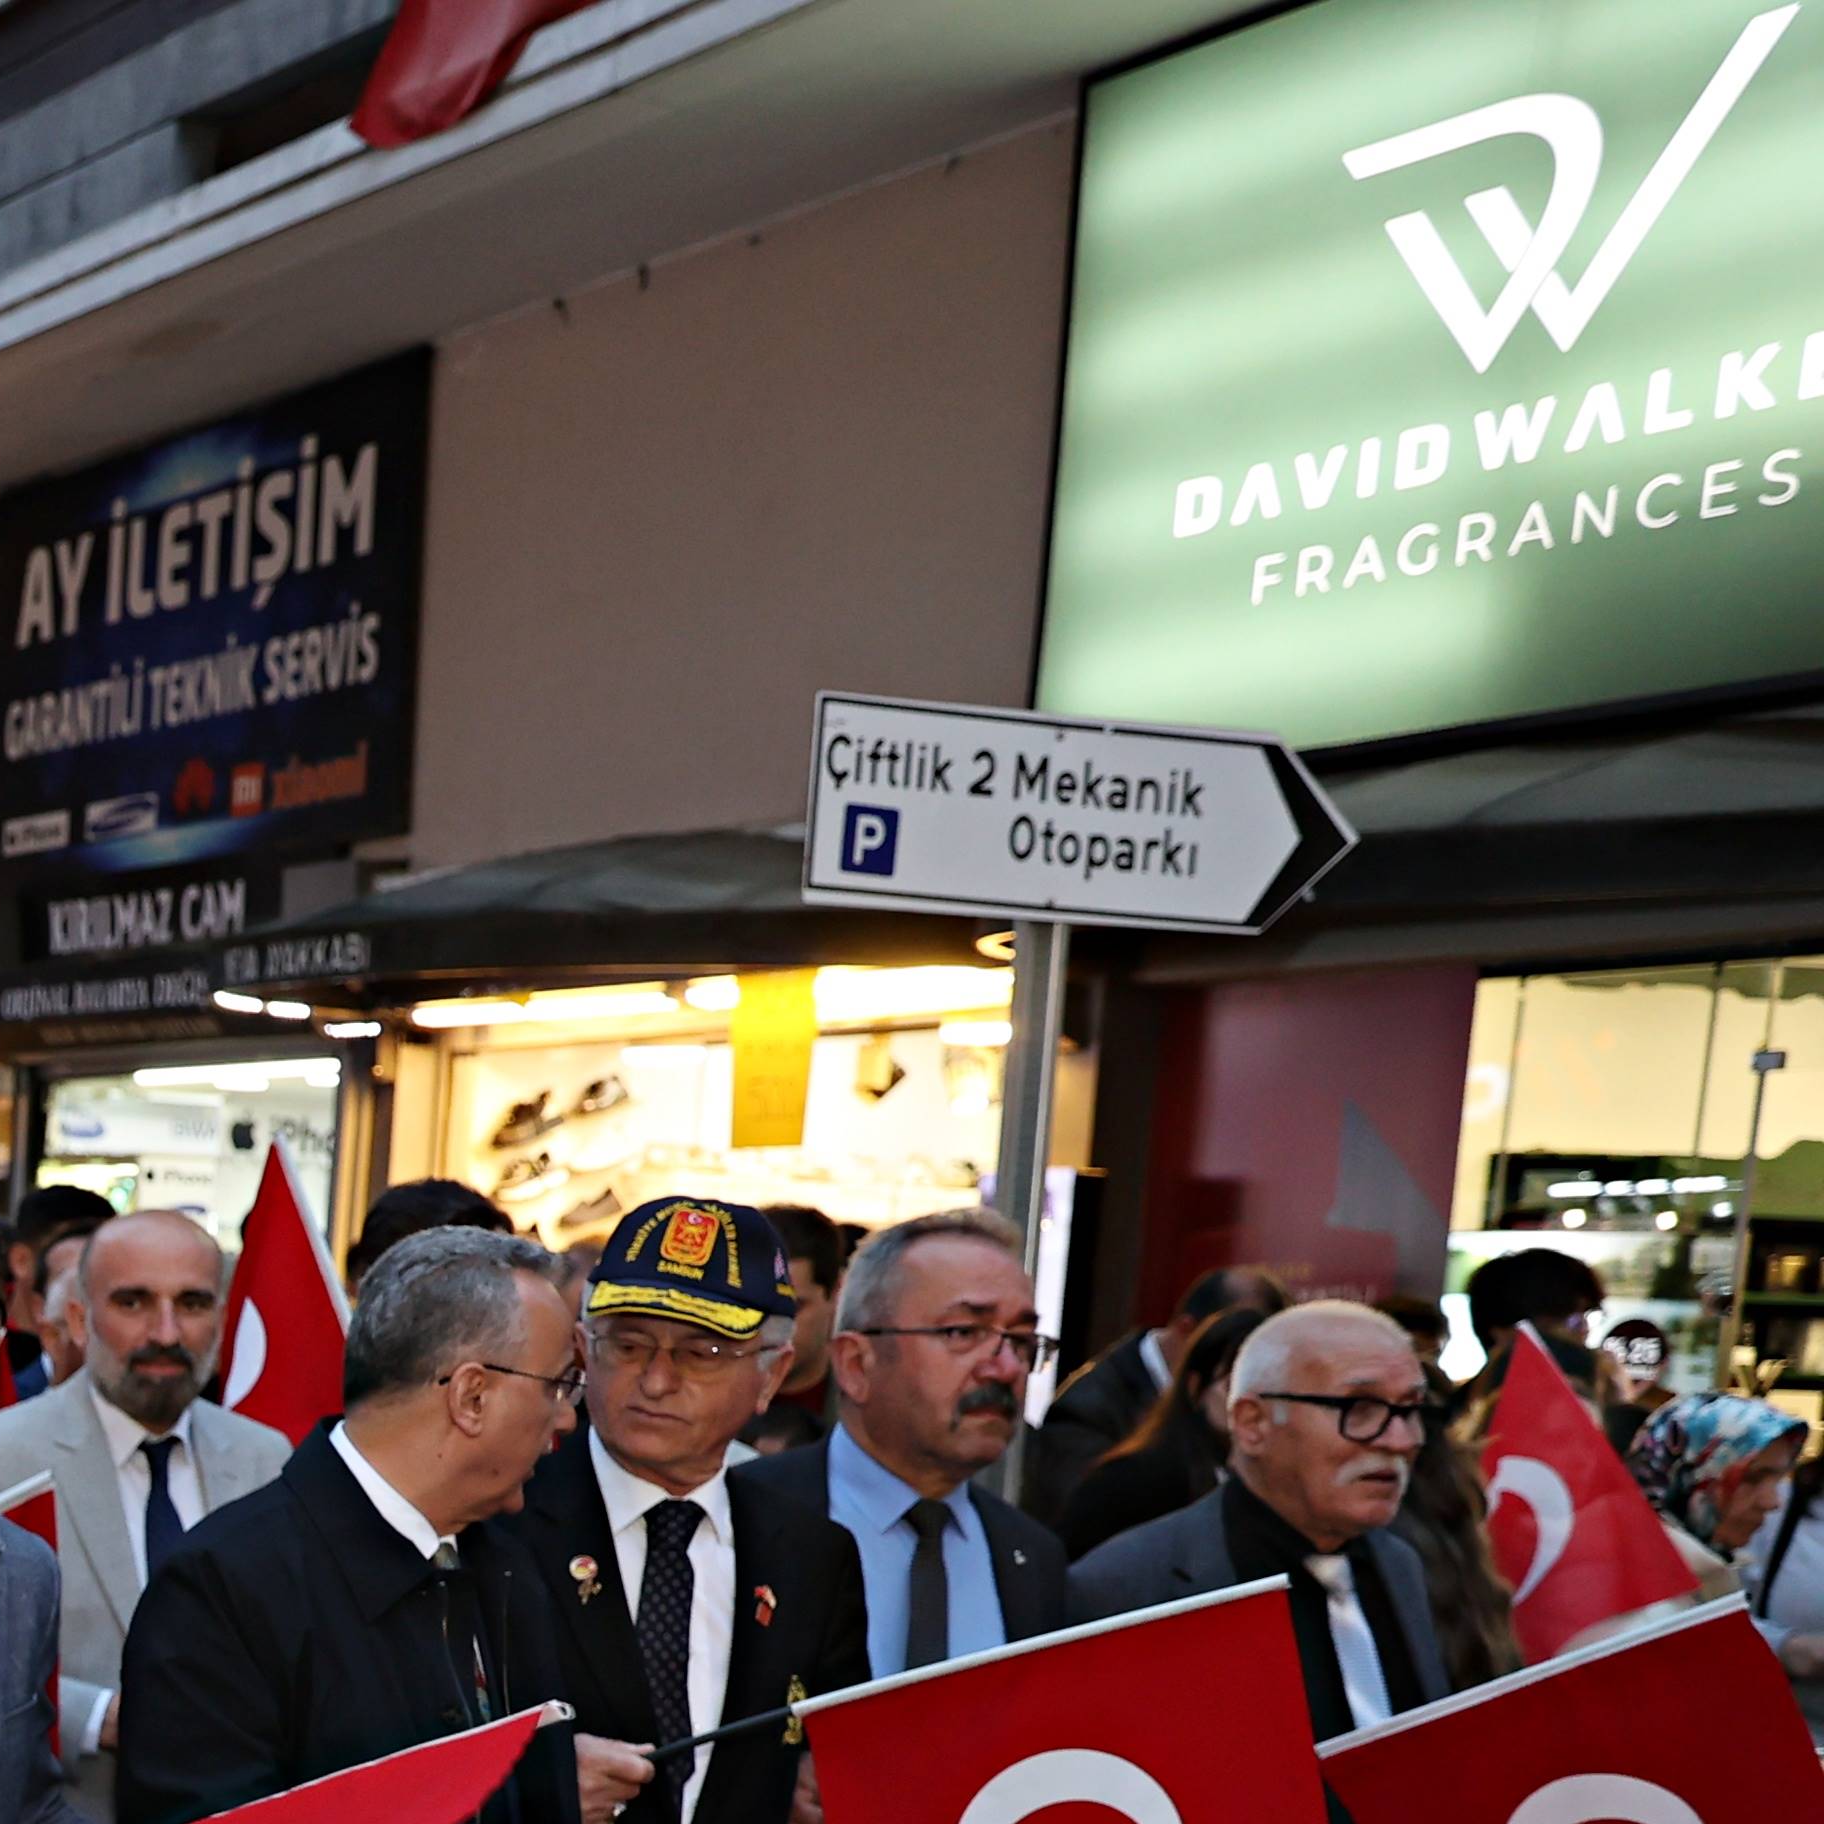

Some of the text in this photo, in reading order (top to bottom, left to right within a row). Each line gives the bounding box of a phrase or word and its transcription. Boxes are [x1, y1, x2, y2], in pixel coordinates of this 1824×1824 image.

[1171, 422, 1452, 539] DAVID
[1250, 448, 1804, 606] FRAGRANCES
[16, 433, 378, 650] AY İLETİŞİM
[148, 632, 257, 731] TEKNİK
[262, 602, 381, 705] SERVİS
[824, 734, 1204, 818] Çiftlik 2 Mekanik
[850, 812, 887, 866] P
[1008, 814, 1199, 880] Otoparkı
[180, 878, 247, 942] CAM
